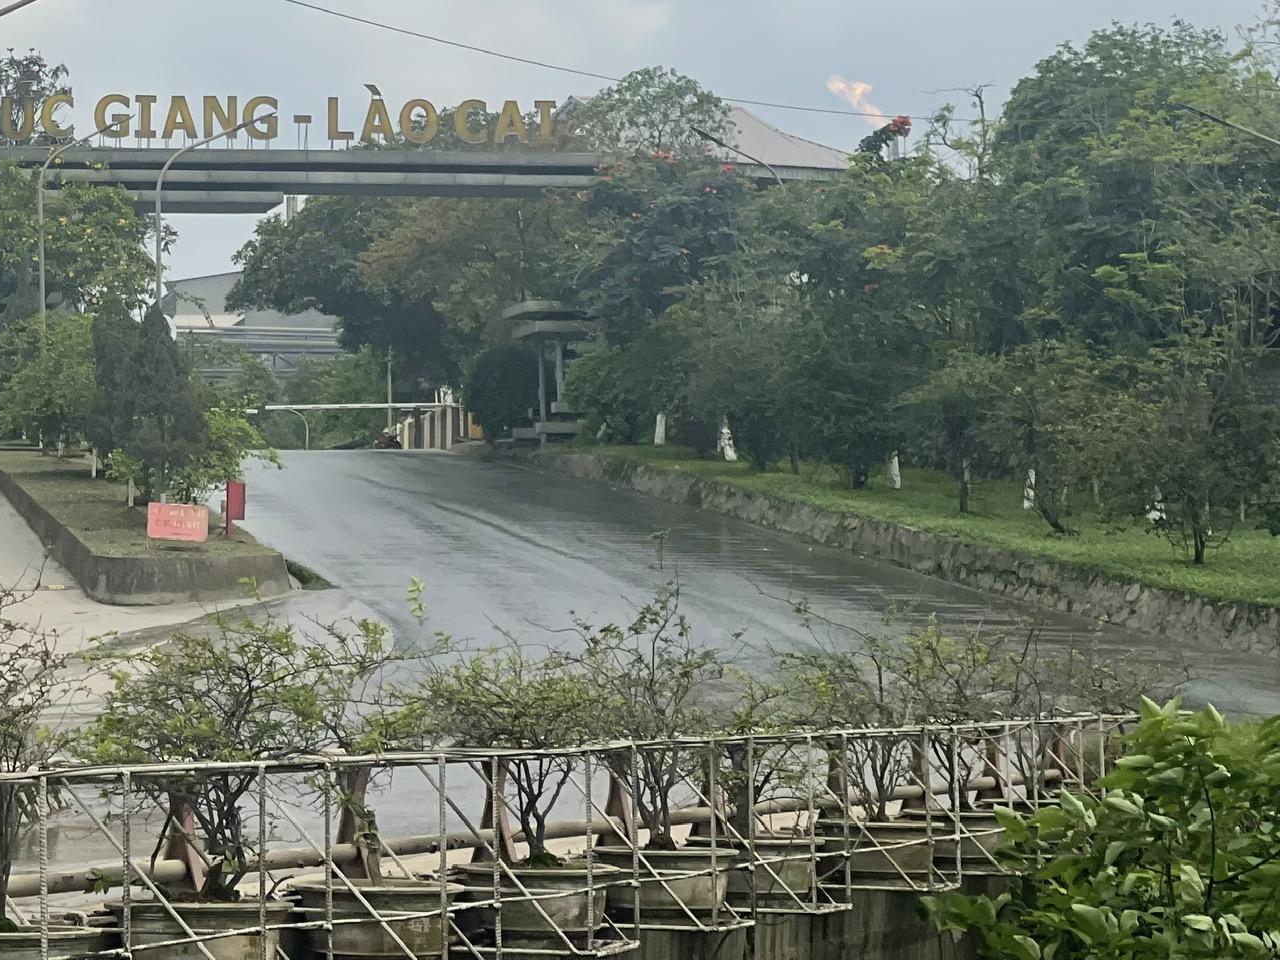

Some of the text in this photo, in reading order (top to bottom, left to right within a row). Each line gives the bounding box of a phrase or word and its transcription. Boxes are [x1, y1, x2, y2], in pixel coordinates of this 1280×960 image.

[94, 93, 278, 141] GIANG
[327, 84, 438, 144] LÀO
[455, 99, 558, 144] CAI
